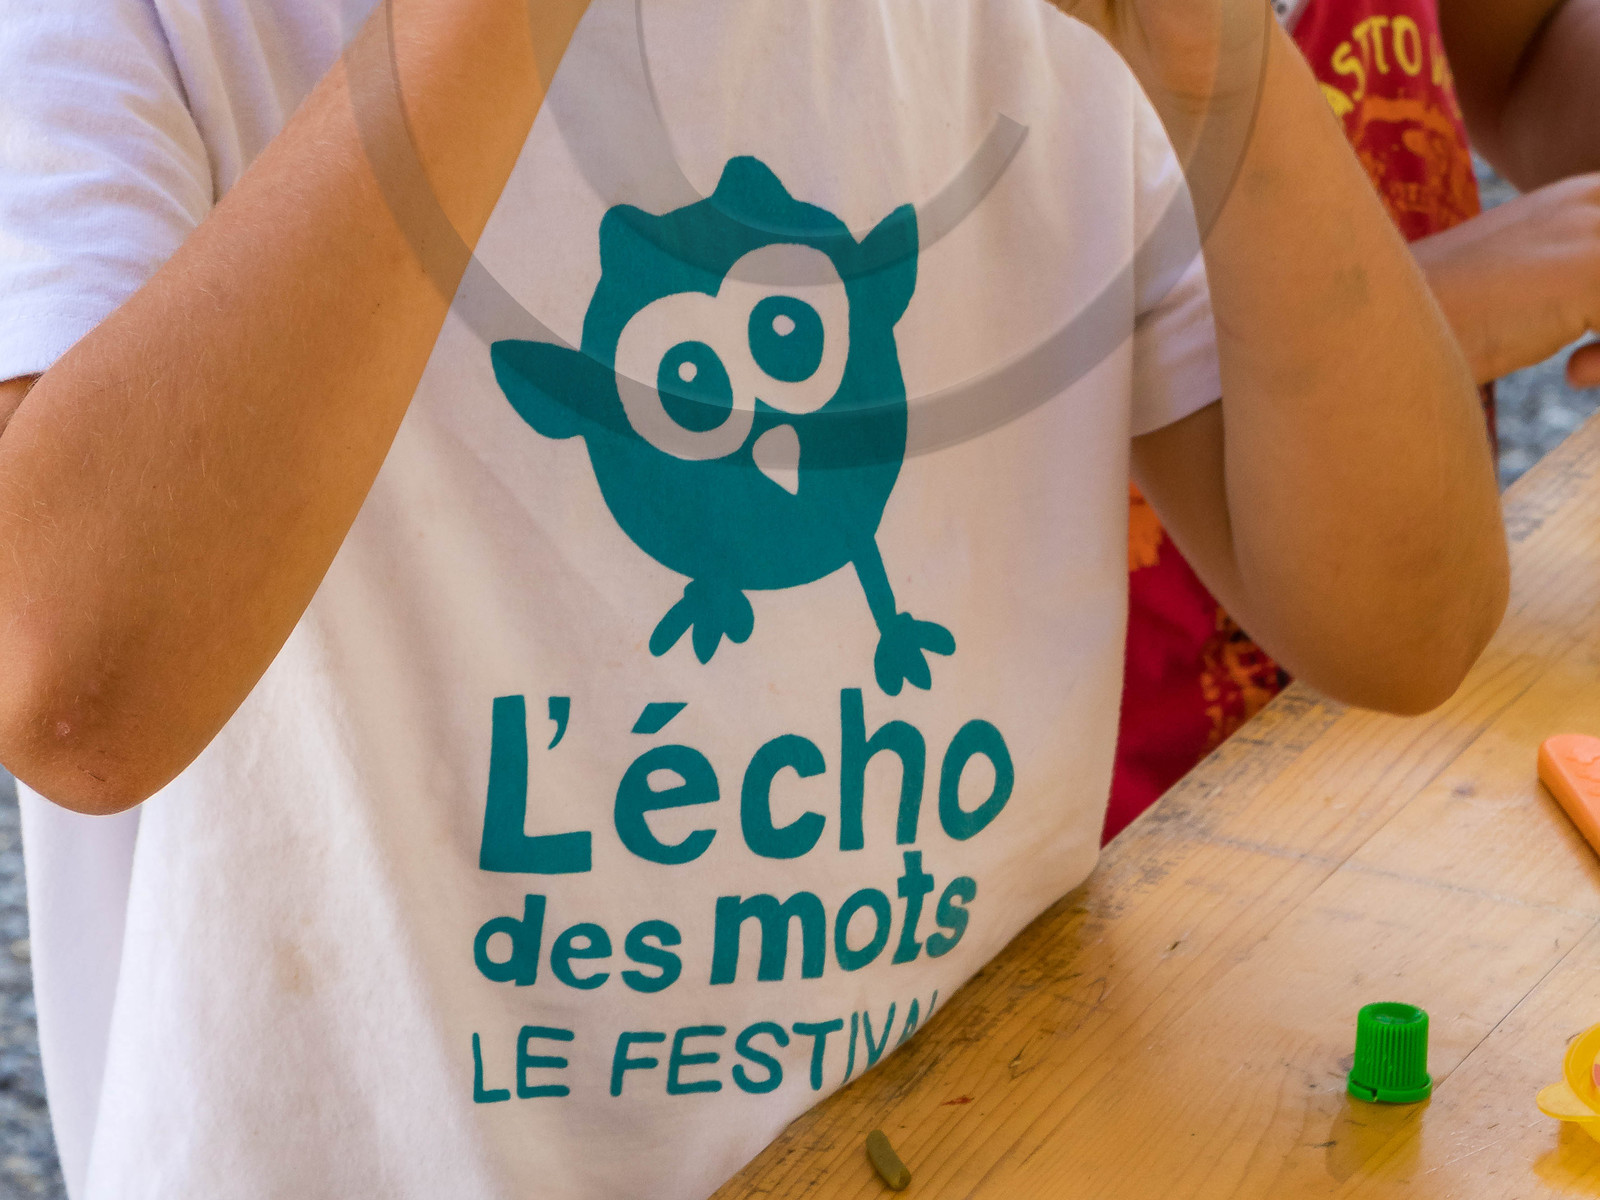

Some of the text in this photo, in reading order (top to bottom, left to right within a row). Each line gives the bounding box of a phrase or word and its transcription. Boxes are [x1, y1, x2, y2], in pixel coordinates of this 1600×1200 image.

[478, 687, 1015, 875] L'écho
[472, 850, 977, 994] des mots
[471, 1024, 575, 1105] LE
